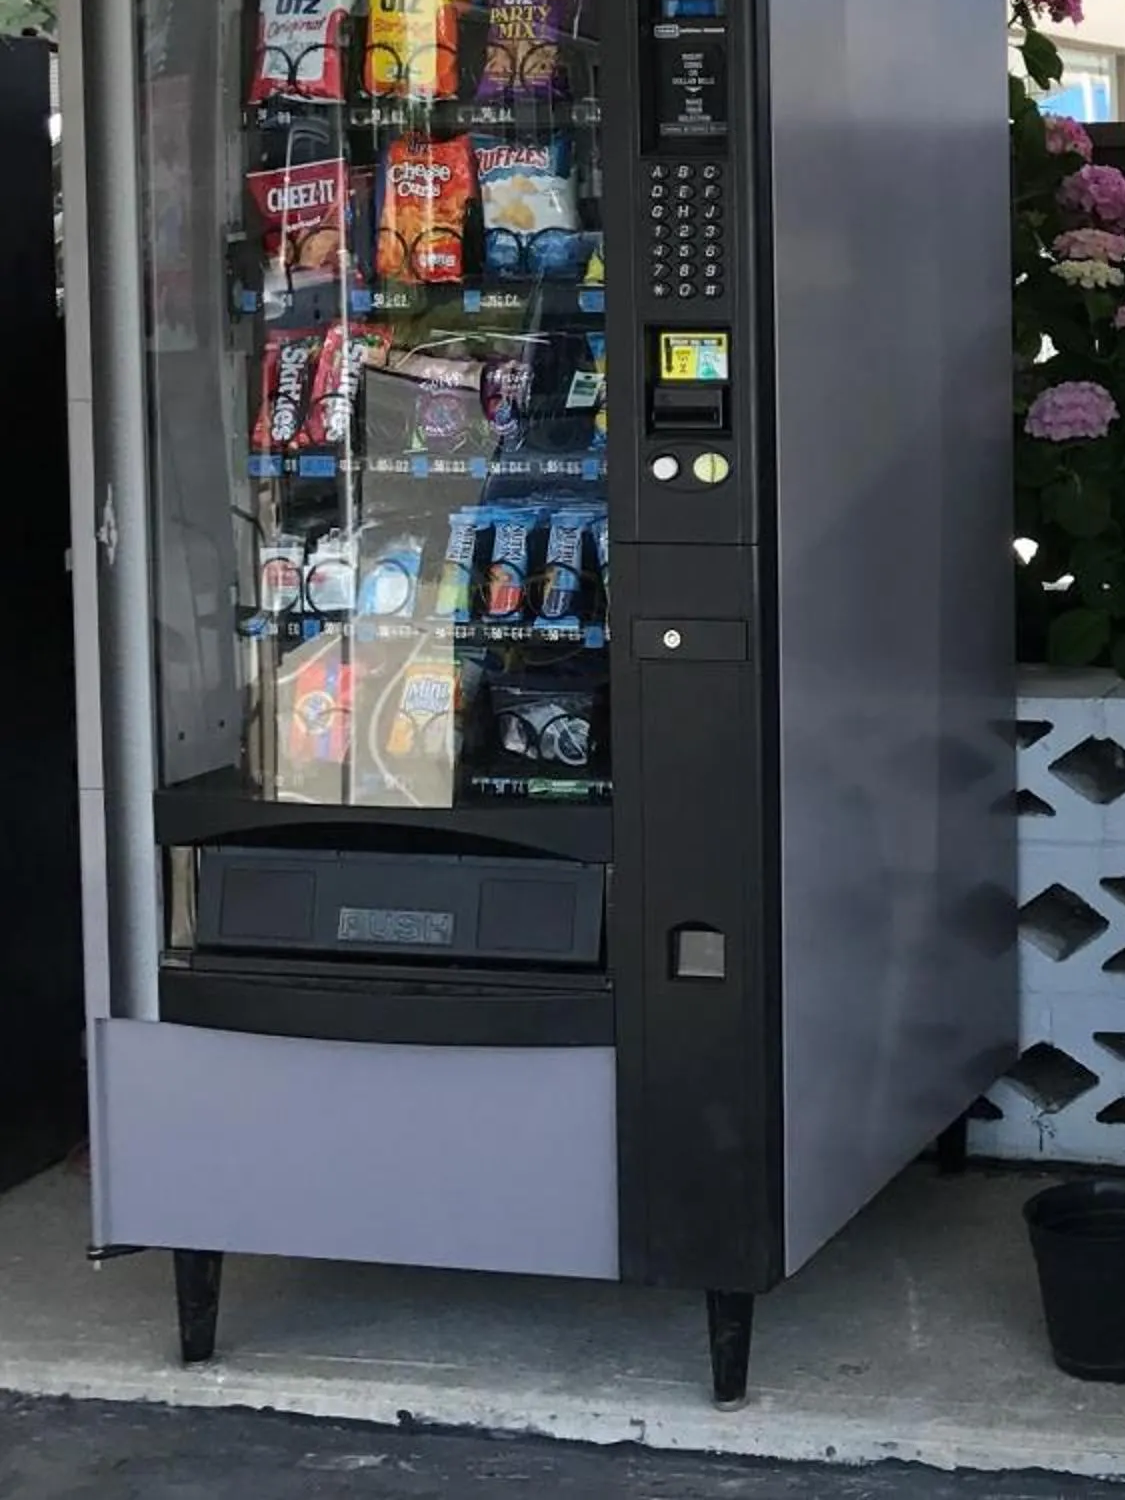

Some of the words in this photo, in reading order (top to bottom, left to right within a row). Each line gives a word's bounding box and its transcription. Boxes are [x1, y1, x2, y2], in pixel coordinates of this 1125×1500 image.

[490, 4, 551, 25] PARTY
[498, 22, 537, 39] MIX
[389, 161, 452, 182] Cheese
[652, 165, 662, 178] A
[678, 165, 689, 179] B
[703, 165, 715, 179] C
[267, 179, 335, 213] CHEEZ-IT
[651, 185, 663, 198] D
[679, 185, 689, 198] E
[705, 185, 715, 198] F
[651, 205, 664, 218] G
[677, 205, 689, 218] H
[705, 205, 715, 218] J
[654, 225, 662, 237] 1
[679, 225, 689, 237] 2
[705, 225, 716, 237] 3
[653, 245, 663, 257] 4
[679, 245, 689, 257] 5
[705, 245, 715, 257] 6
[653, 263, 664, 276] 7
[679, 263, 689, 277] 8
[705, 263, 716, 277] 9
[679, 283, 691, 297] 0
[272, 346, 308, 441] Skittles
